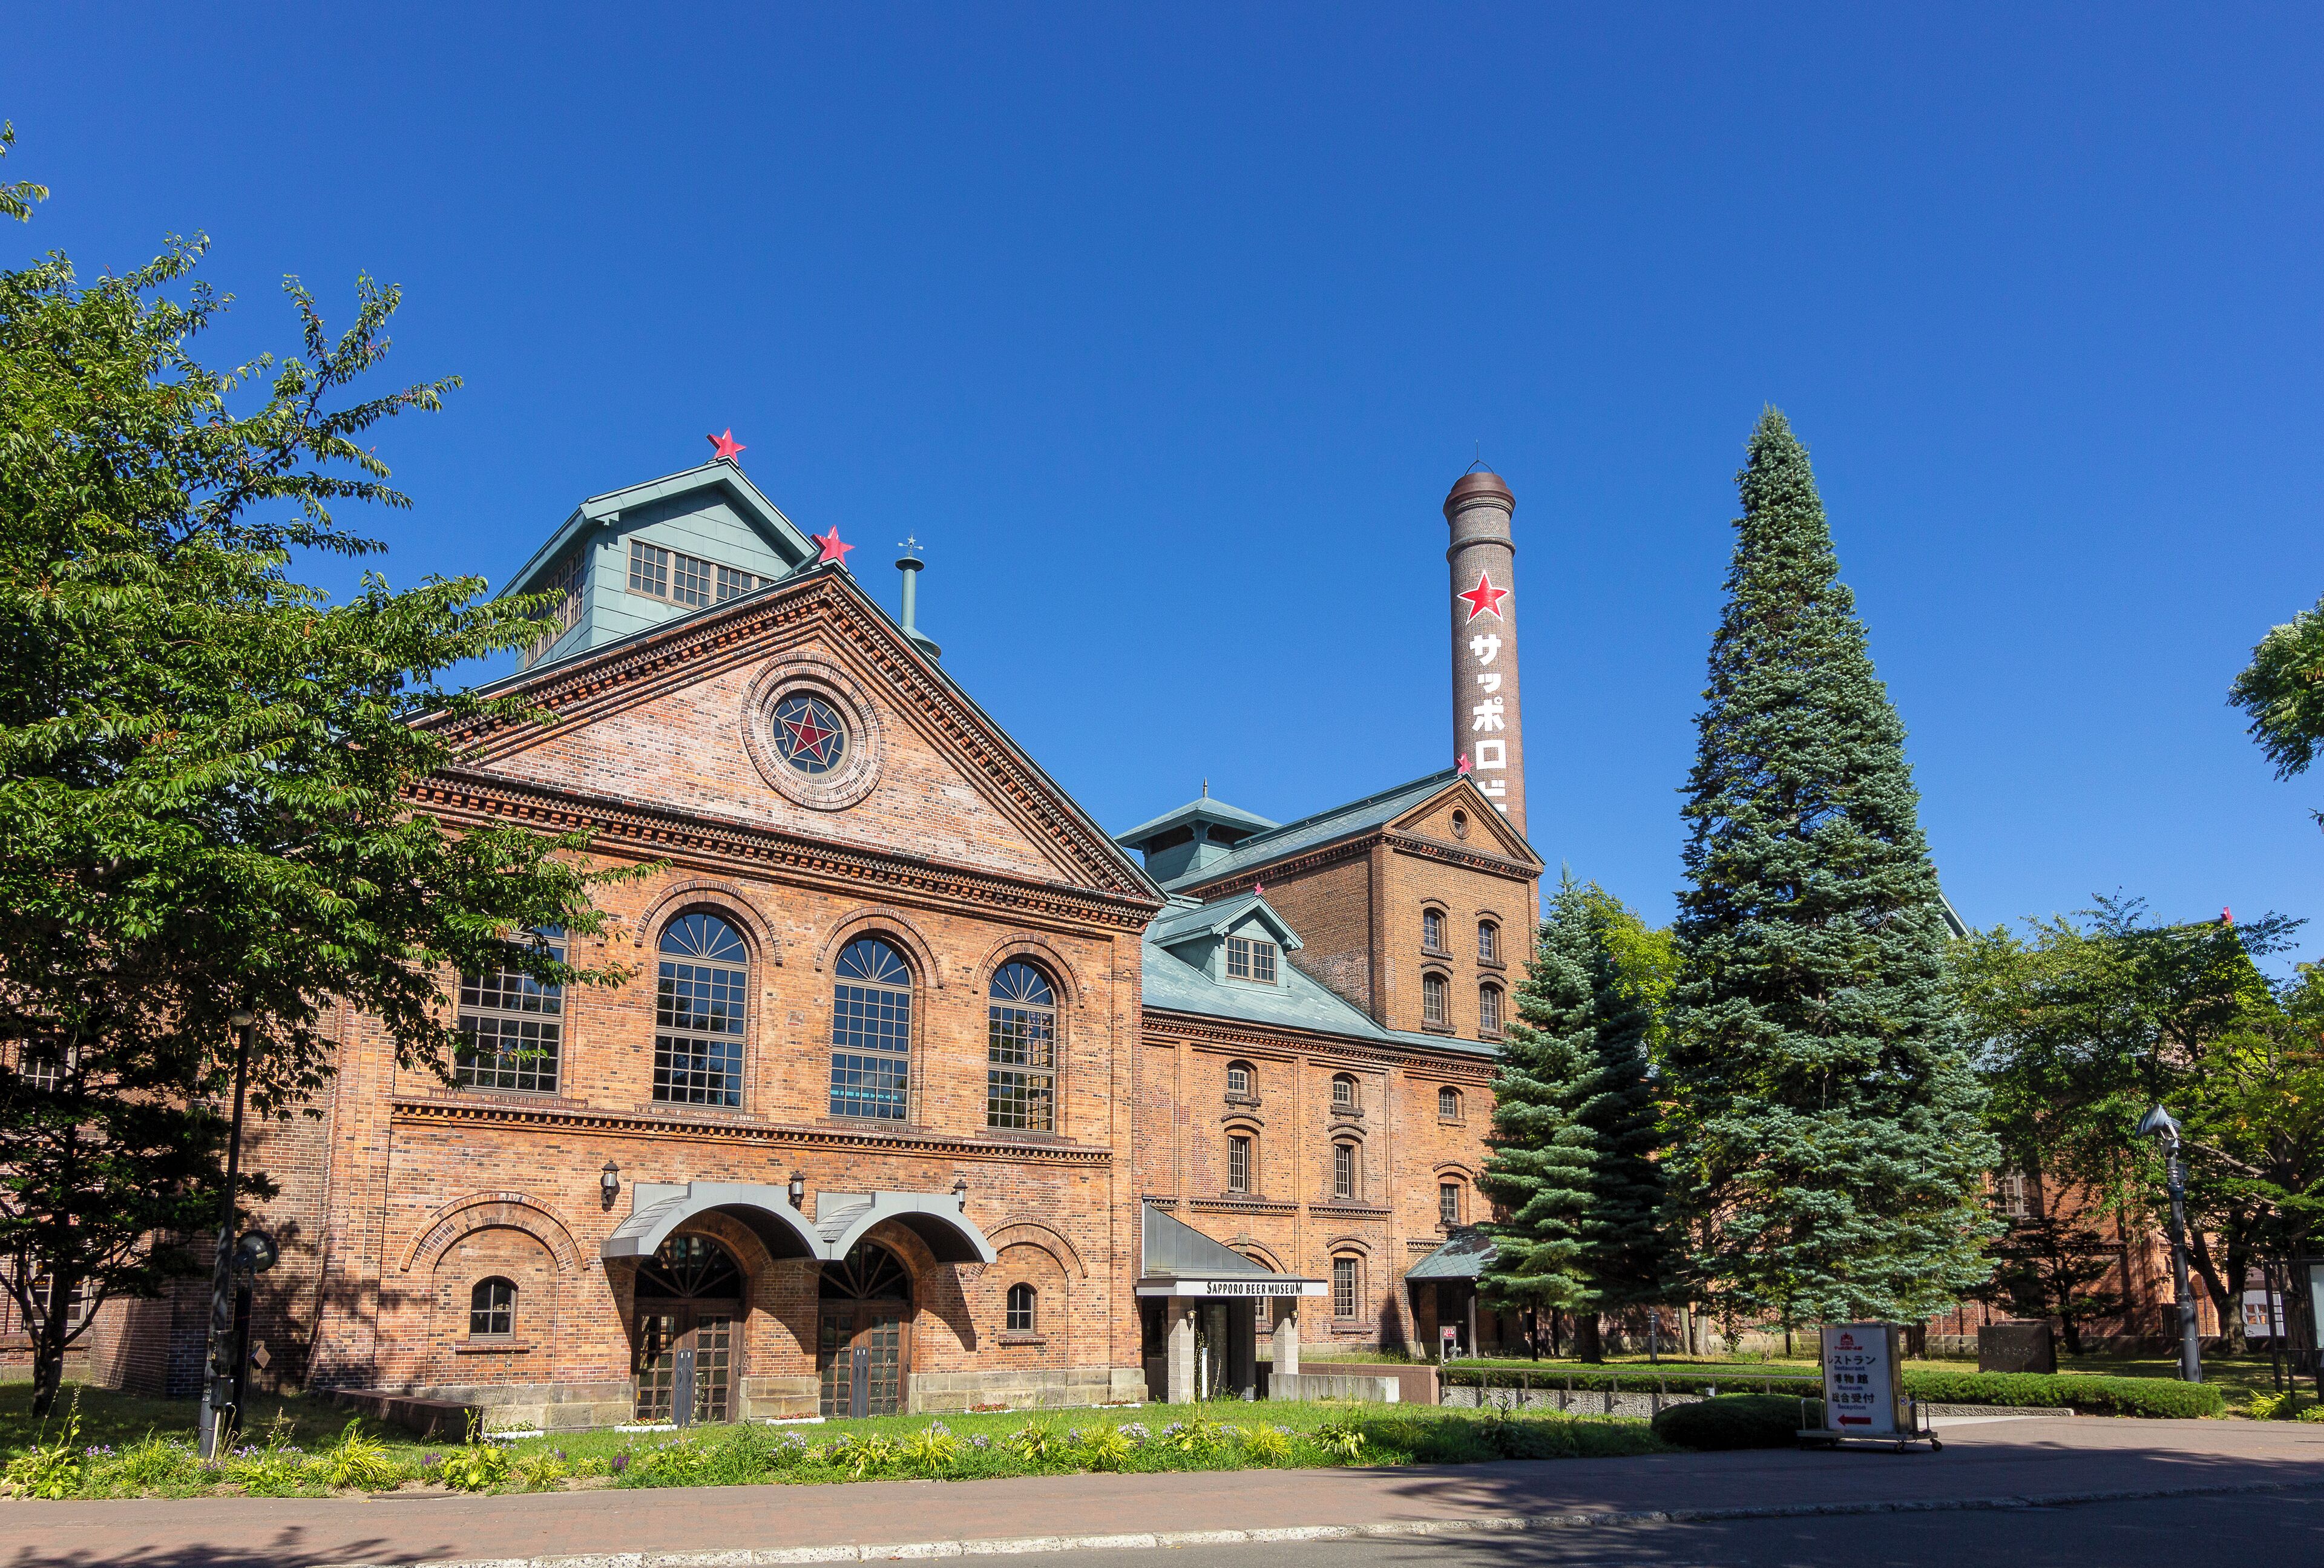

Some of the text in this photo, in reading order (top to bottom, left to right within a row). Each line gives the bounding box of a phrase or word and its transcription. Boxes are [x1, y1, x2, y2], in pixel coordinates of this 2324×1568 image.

[1207, 1281, 1302, 1294] SAPPORO BEER MUSEUM
[1828, 1355, 1876, 1365] レストラン
[1833, 1373, 1868, 1385] 博物館
[1832, 1393, 1875, 1403] 総合受付
